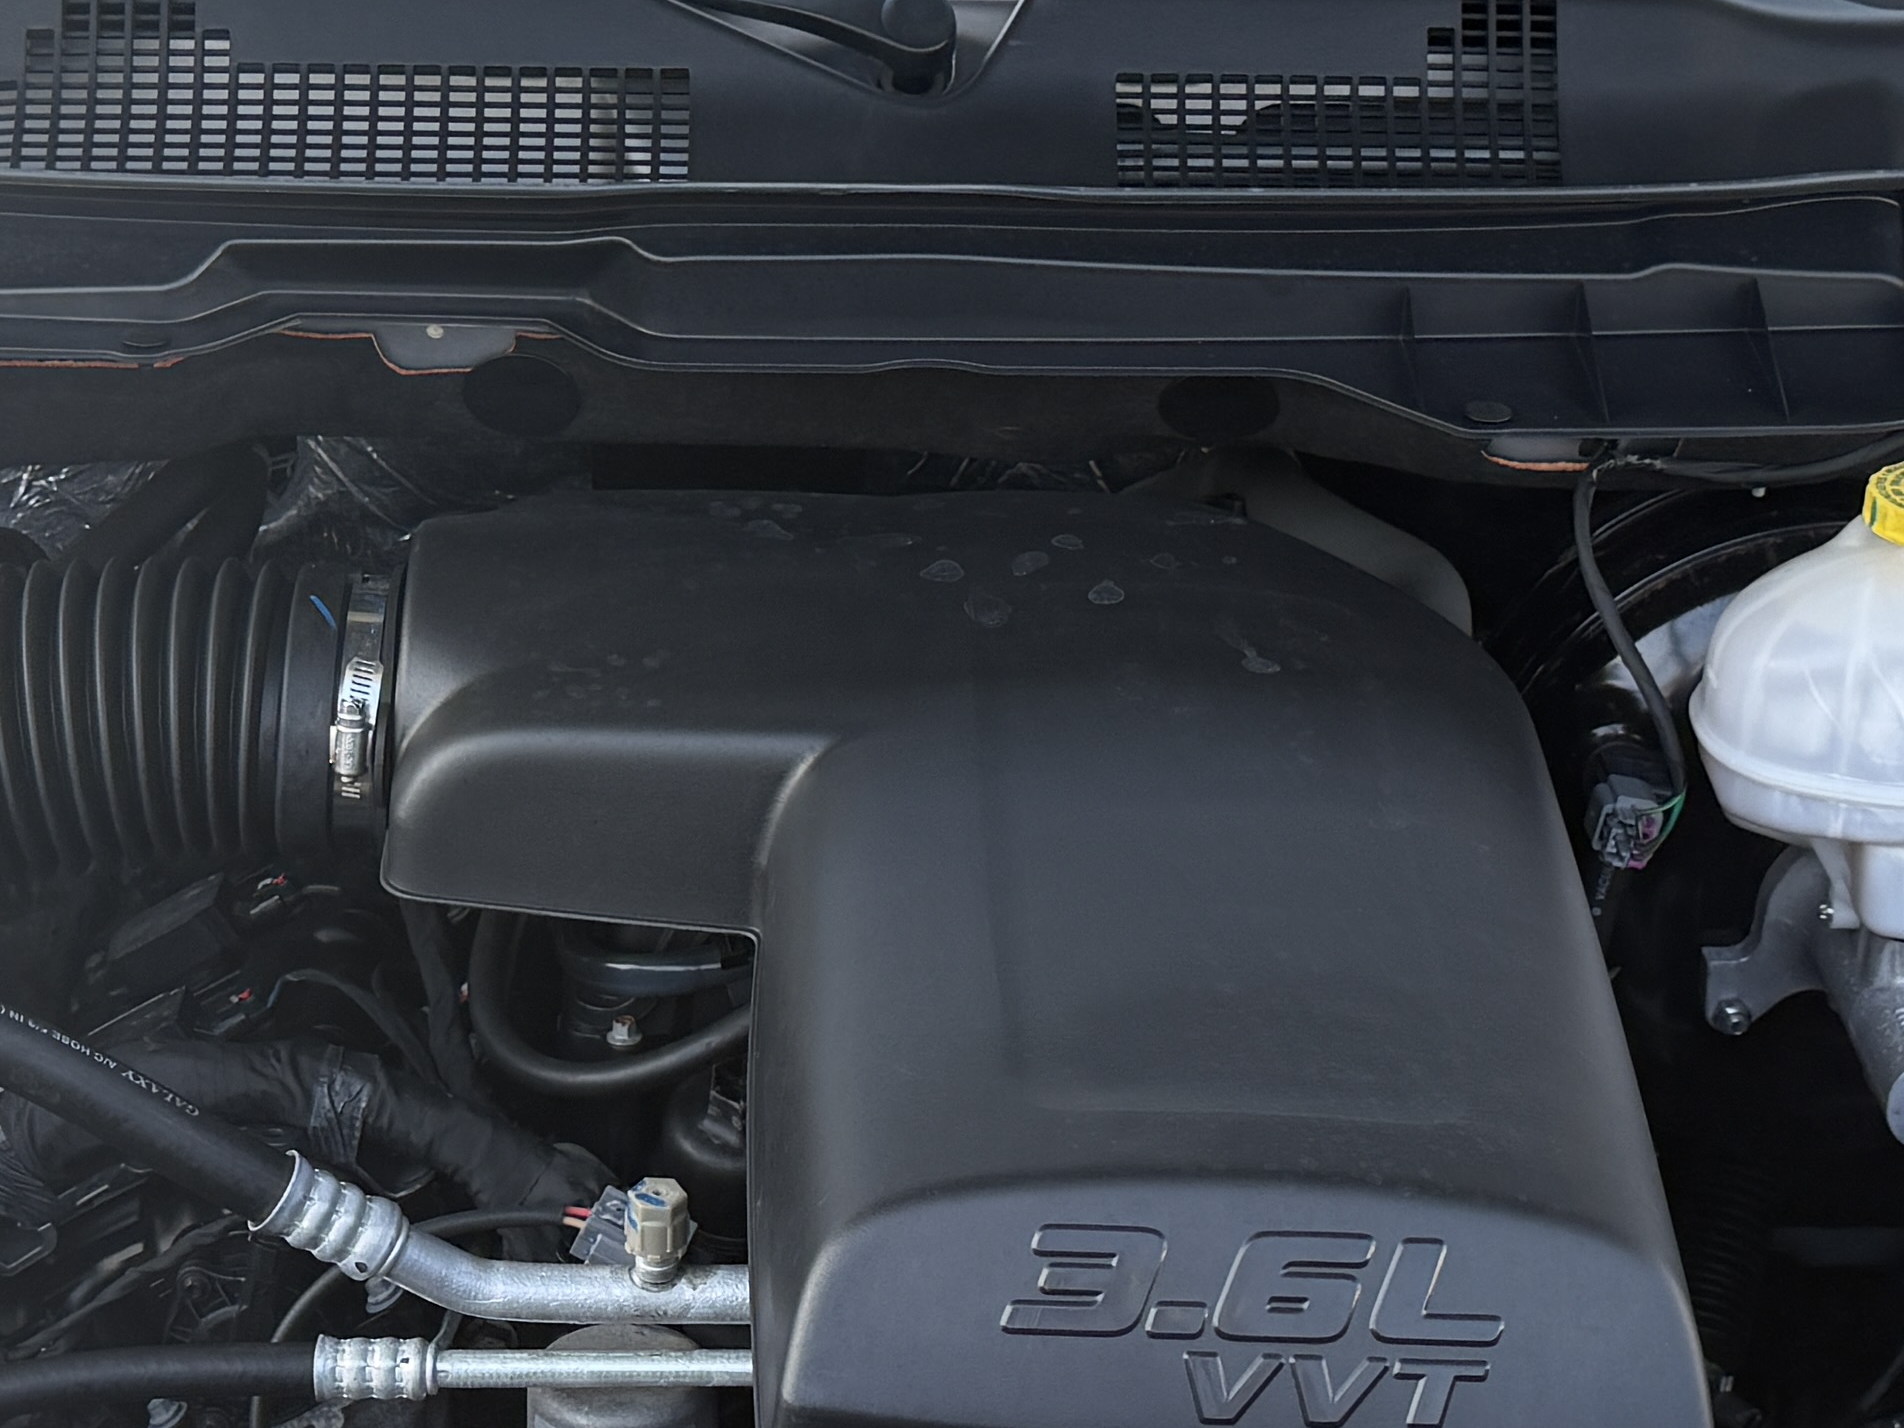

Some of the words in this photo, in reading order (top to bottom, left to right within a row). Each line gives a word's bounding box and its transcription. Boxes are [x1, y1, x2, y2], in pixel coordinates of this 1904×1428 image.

[50, 1028, 90, 1055] HOSE
[122, 1067, 200, 1117] GALAXY
[999, 1222, 1505, 1348] 3.6L
